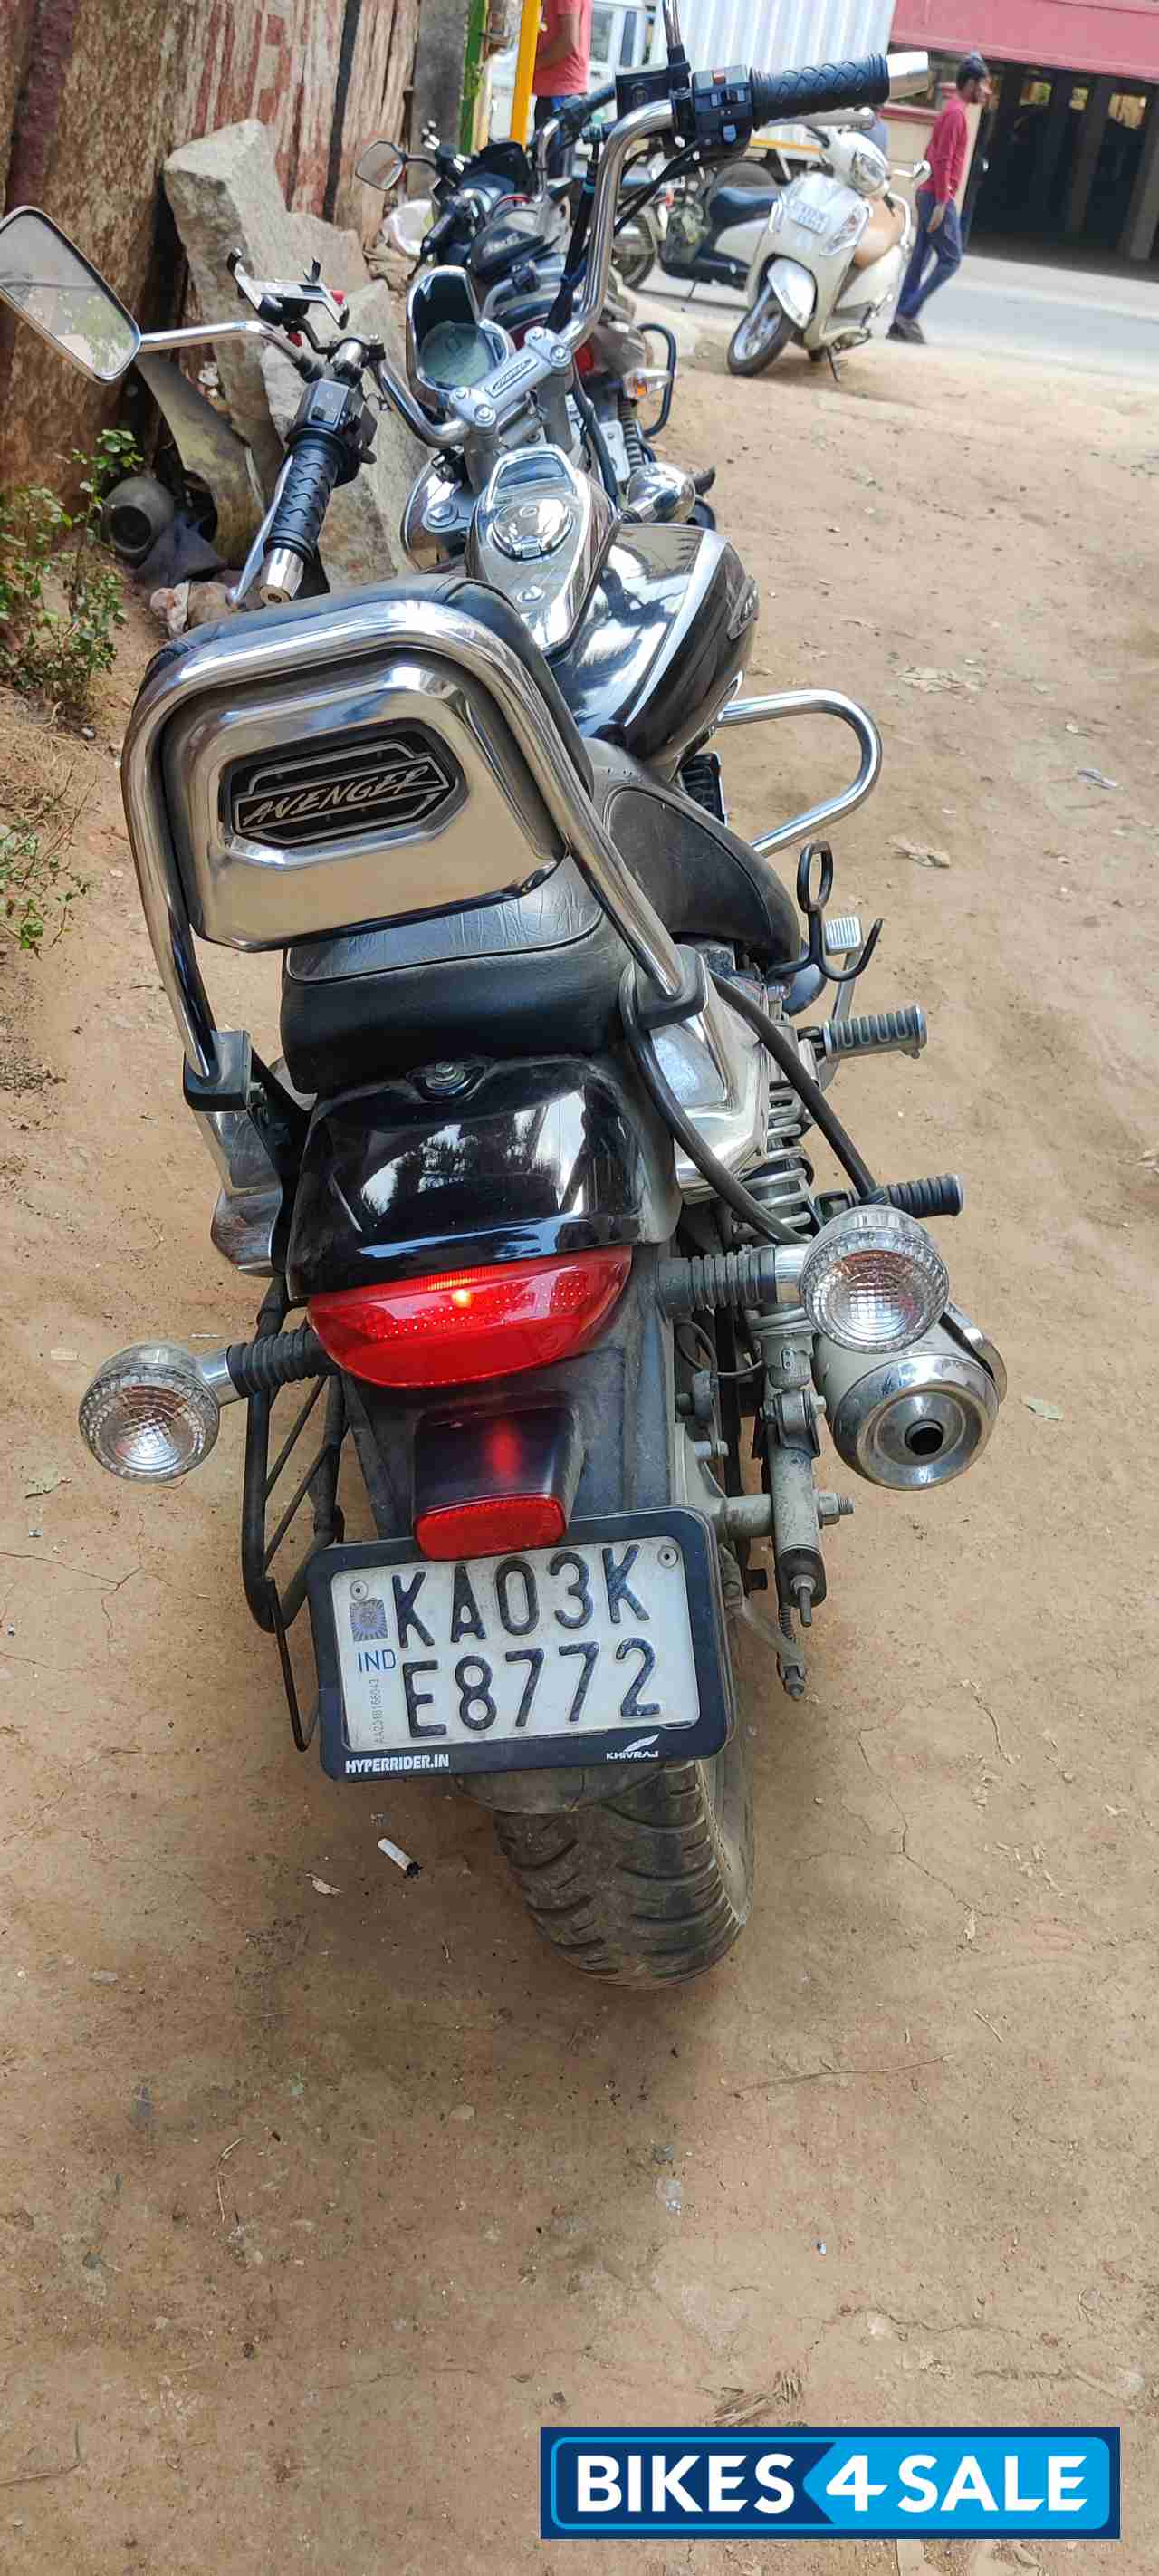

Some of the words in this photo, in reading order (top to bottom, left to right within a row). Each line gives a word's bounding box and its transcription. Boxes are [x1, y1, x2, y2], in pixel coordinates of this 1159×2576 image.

[243, 765, 440, 826] AVENGER
[392, 1544, 650, 1648] KA03K
[358, 1649, 397, 1672] IND
[402, 1637, 660, 1738] E8772
[345, 1754, 450, 1773] HYPERRIDER.IN
[606, 1750, 659, 1760] KHIVRAJ
